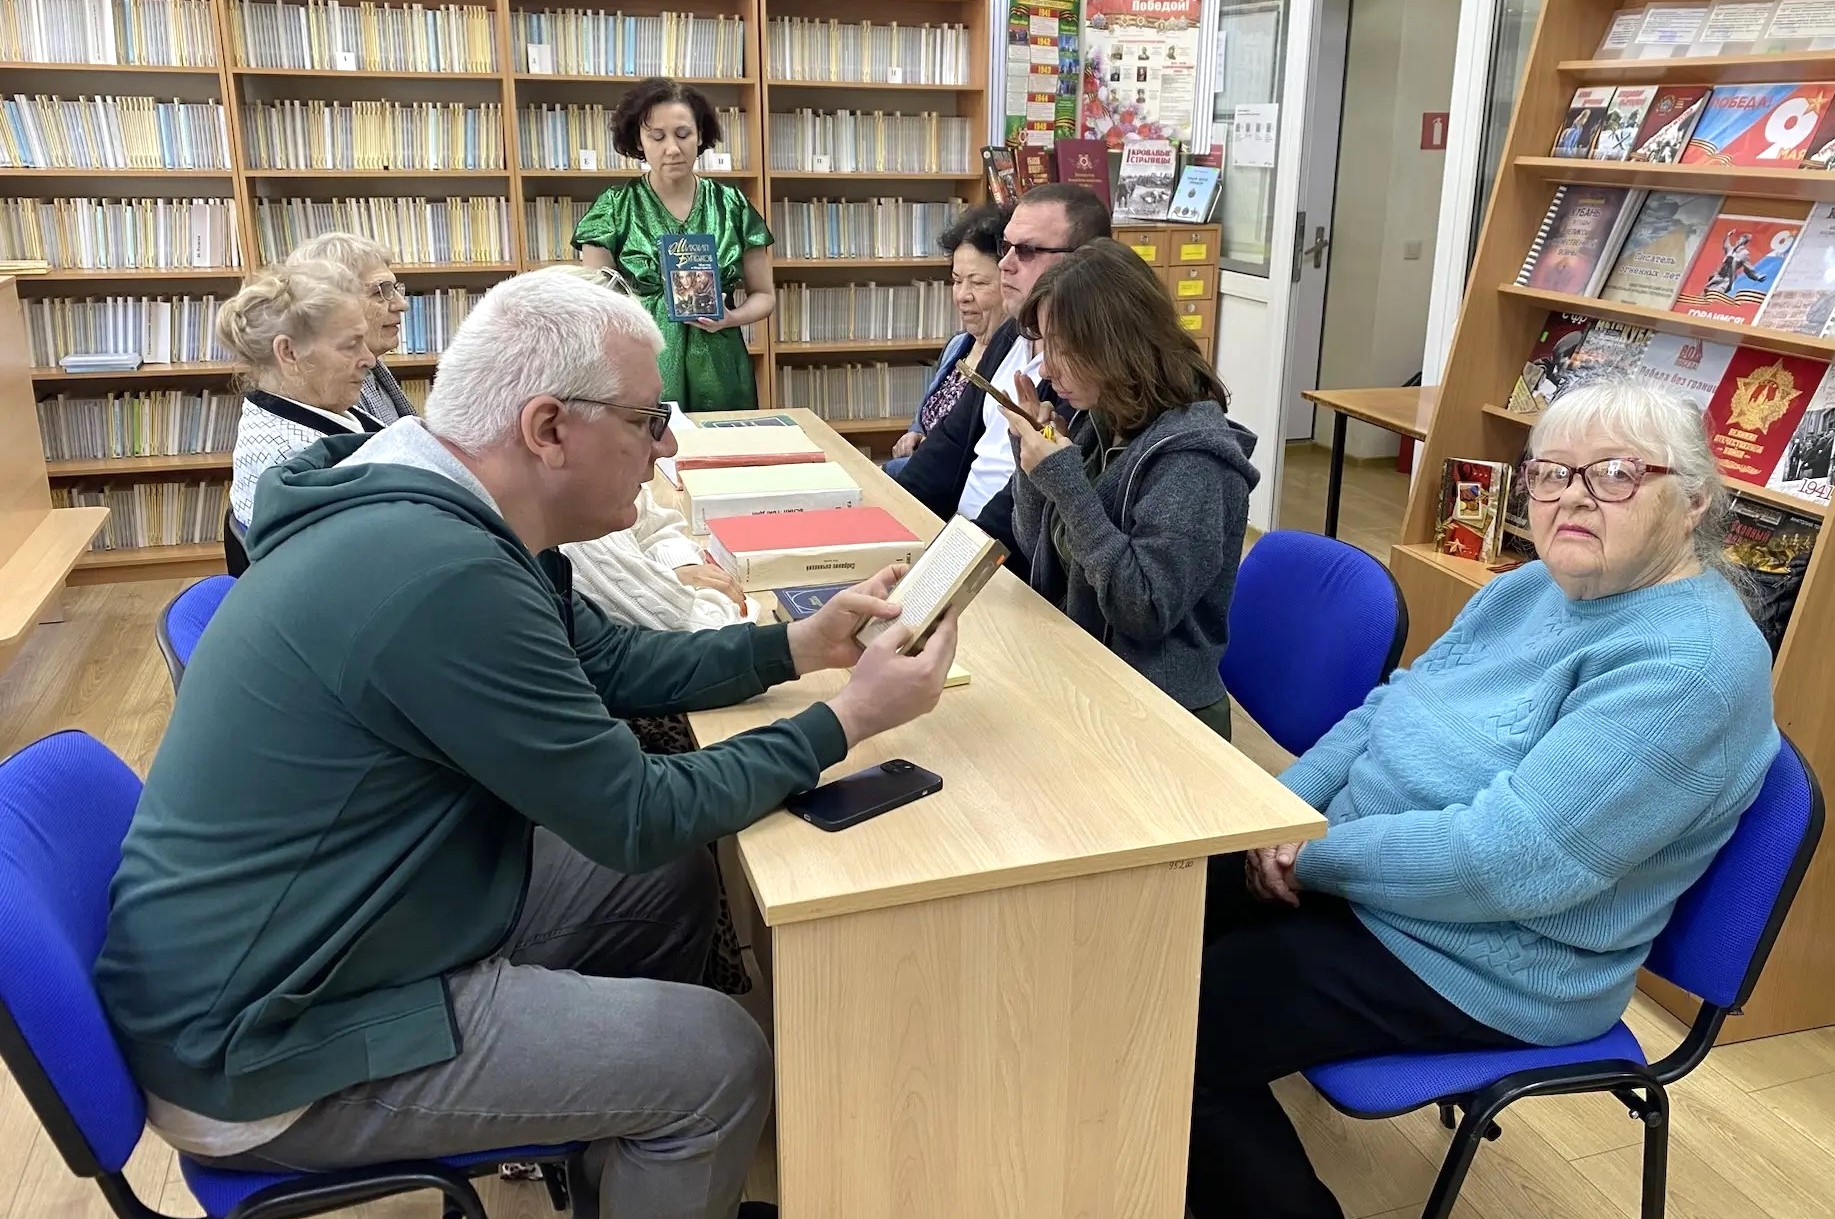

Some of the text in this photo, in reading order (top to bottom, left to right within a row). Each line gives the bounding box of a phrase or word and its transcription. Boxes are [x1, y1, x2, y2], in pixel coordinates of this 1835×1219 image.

[1038, 8, 1051, 17] 1941
[1132, 0, 1190, 12] Победой!
[1037, 37, 1051, 46] 1942
[1712, 96, 1772, 110] ПОБЕДА!
[1756, 97, 1819, 160] 9
[1130, 156, 1171, 165] СТРАНИЦЫ
[1777, 147, 1808, 161] МАЯ
[1634, 252, 1676, 265] Писатель
[1663, 271, 1681, 280] лет
[1671, 373, 1687, 386] без
[1798, 478, 1834, 501] 1941
